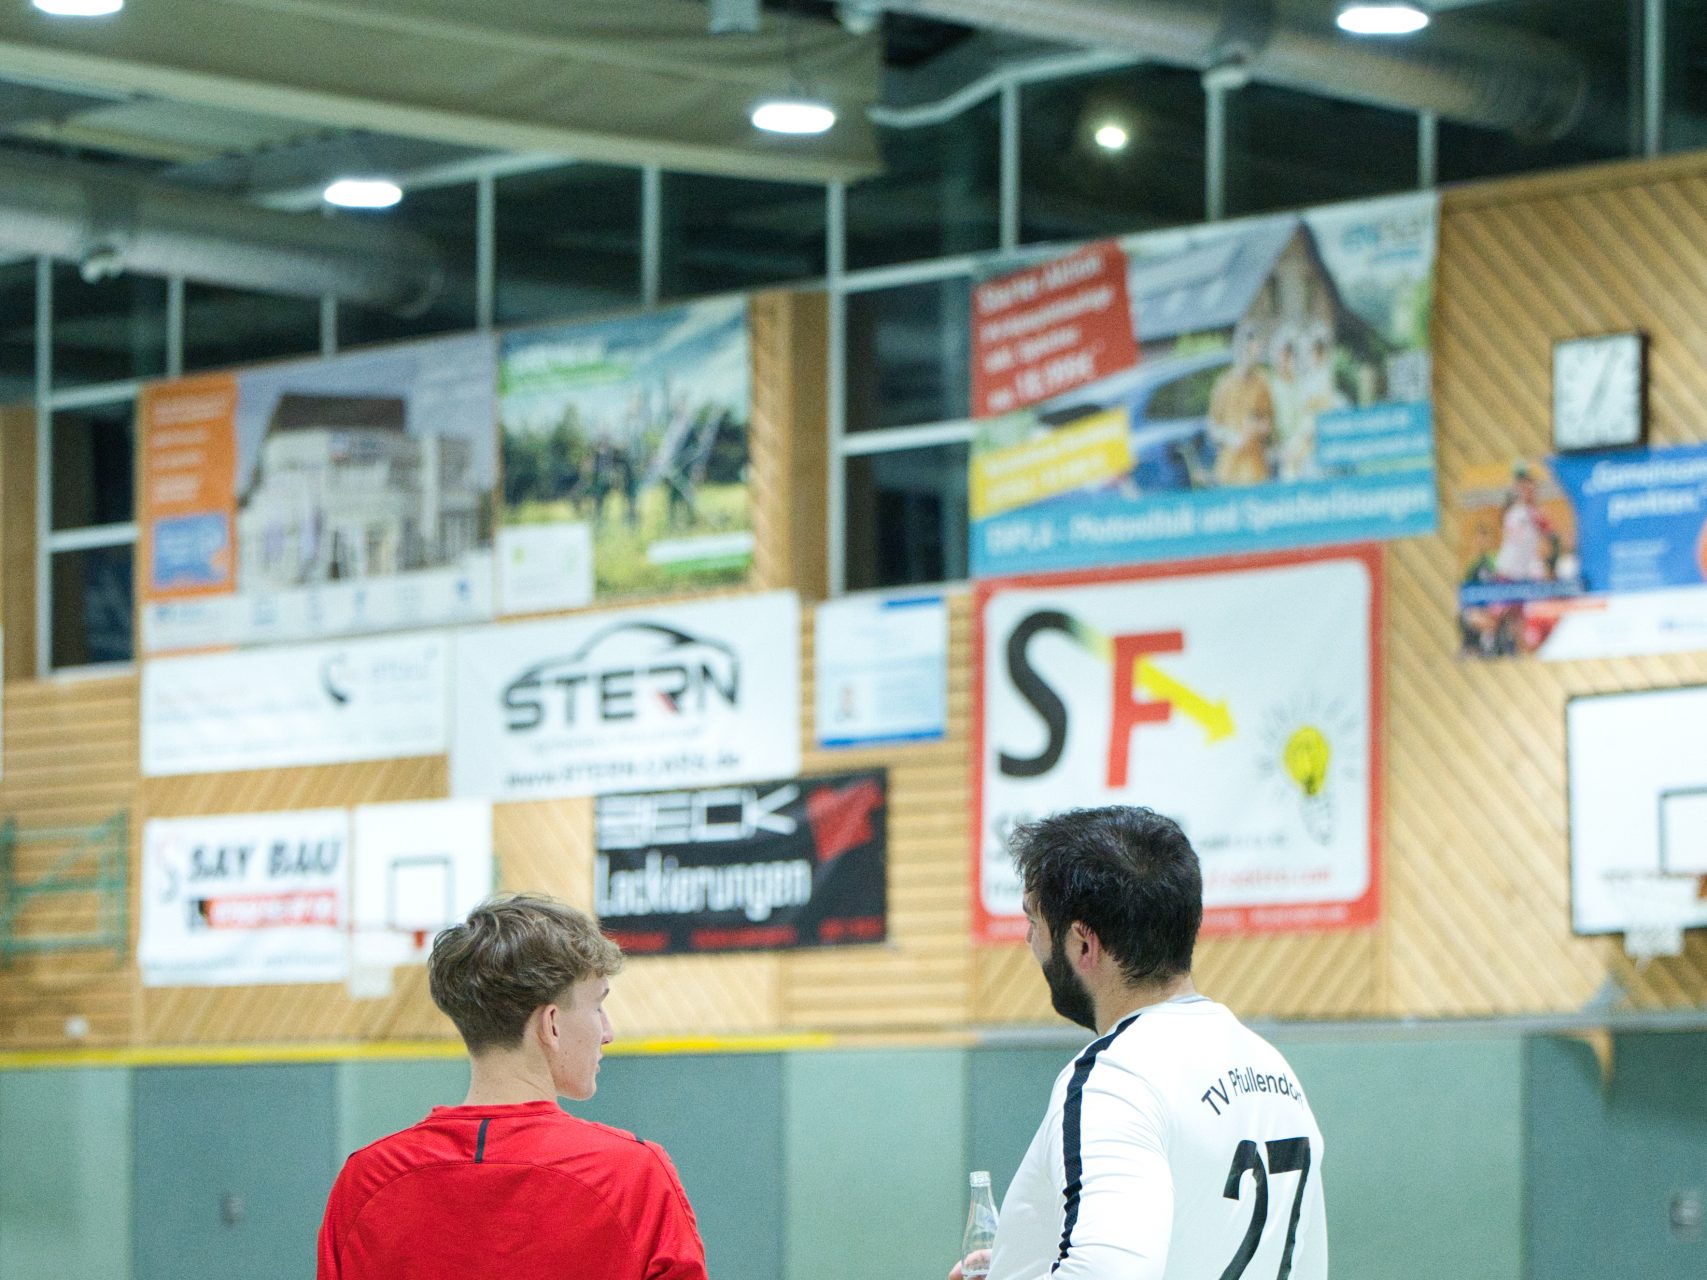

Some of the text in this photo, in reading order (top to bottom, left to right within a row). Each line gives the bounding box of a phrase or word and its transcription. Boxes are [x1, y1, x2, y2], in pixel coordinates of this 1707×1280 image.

[502, 660, 741, 733] STERN
[594, 850, 812, 922] Lackierungen
[1200, 1077, 1230, 1116] TV
